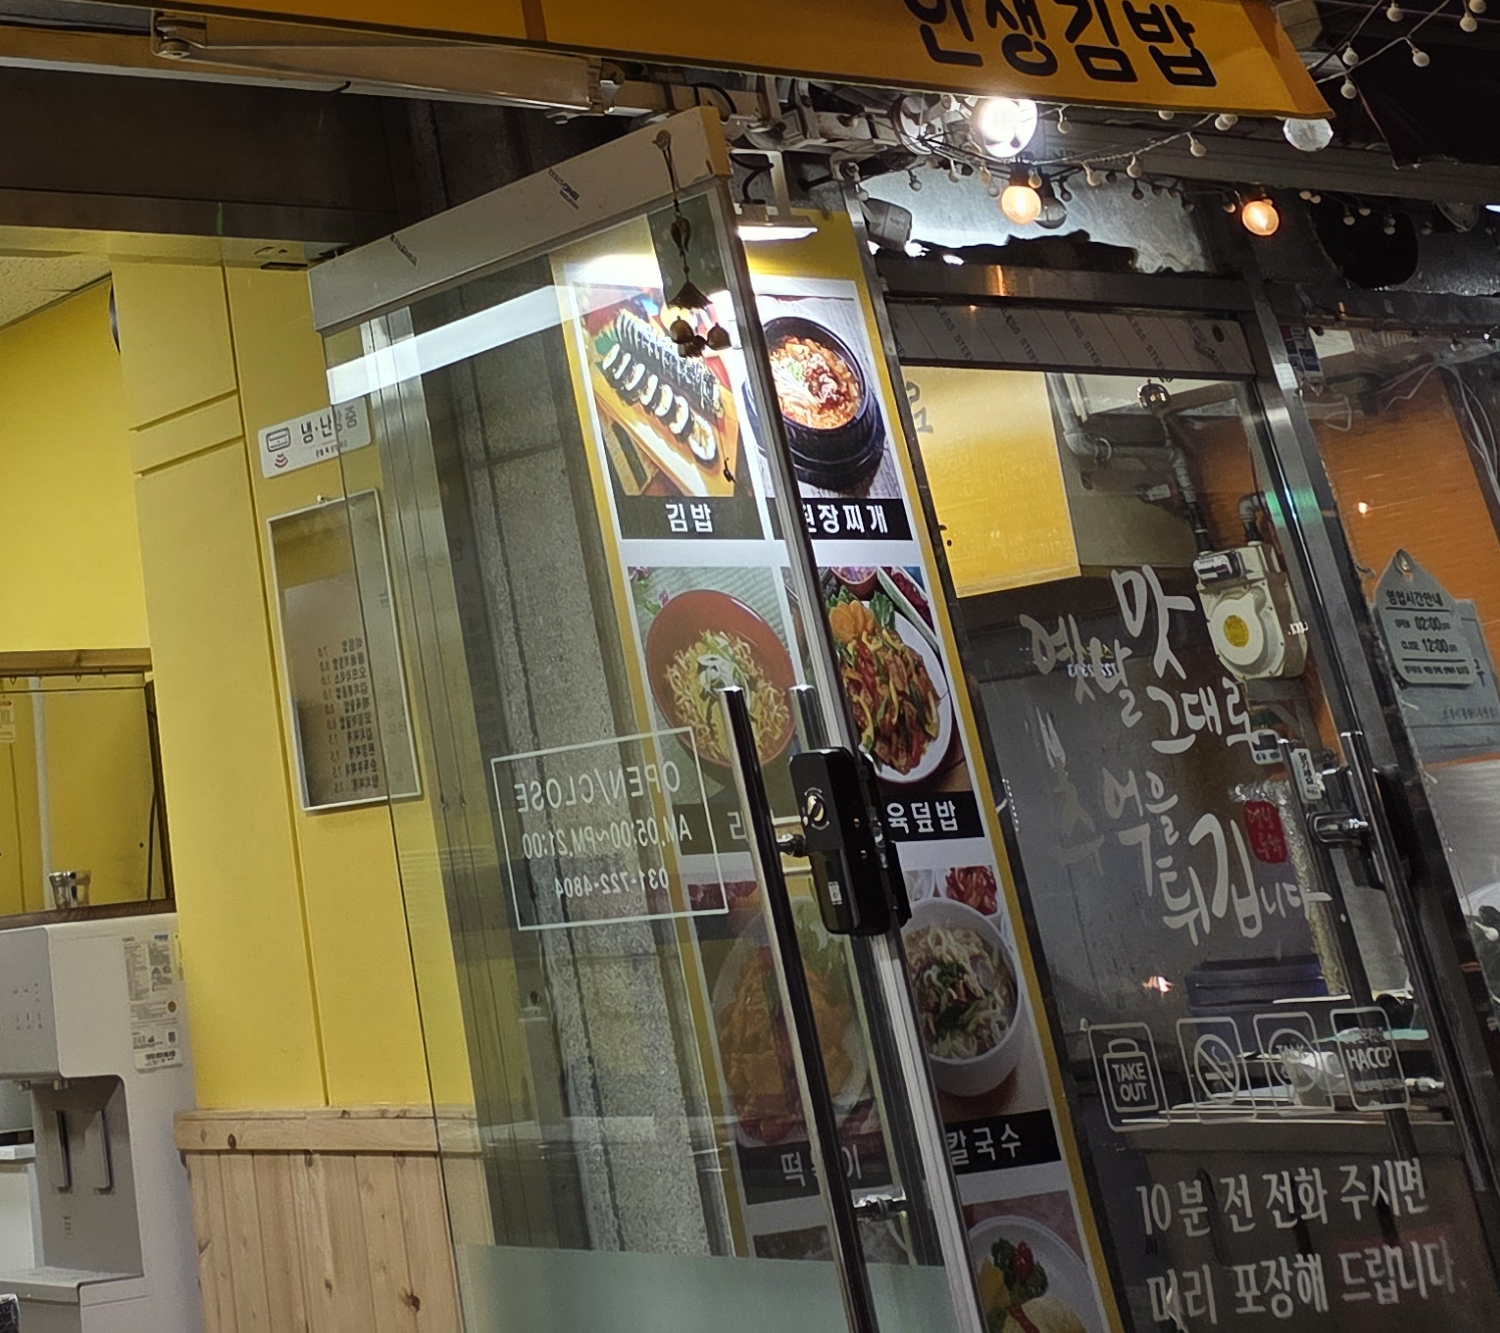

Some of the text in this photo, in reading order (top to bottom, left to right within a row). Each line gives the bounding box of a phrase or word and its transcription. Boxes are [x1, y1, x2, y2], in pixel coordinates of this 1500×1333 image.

[665, 502, 713, 532] 김밥
[1110, 564, 1197, 681] 맛
[1146, 675, 1261, 754] 그대로
[886, 800, 958, 834] 육덮밥
[1111, 1062, 1145, 1082] TAKE
[1346, 1046, 1394, 1071] HACCP
[1119, 1082, 1148, 1103] OUT
[946, 1123, 1022, 1166] 칼국수
[1136, 1157, 1430, 1237] 10분 전 전화 주시면
[1146, 1263, 1219, 1326] 미리
[1230, 1253, 1330, 1318] 포장해
